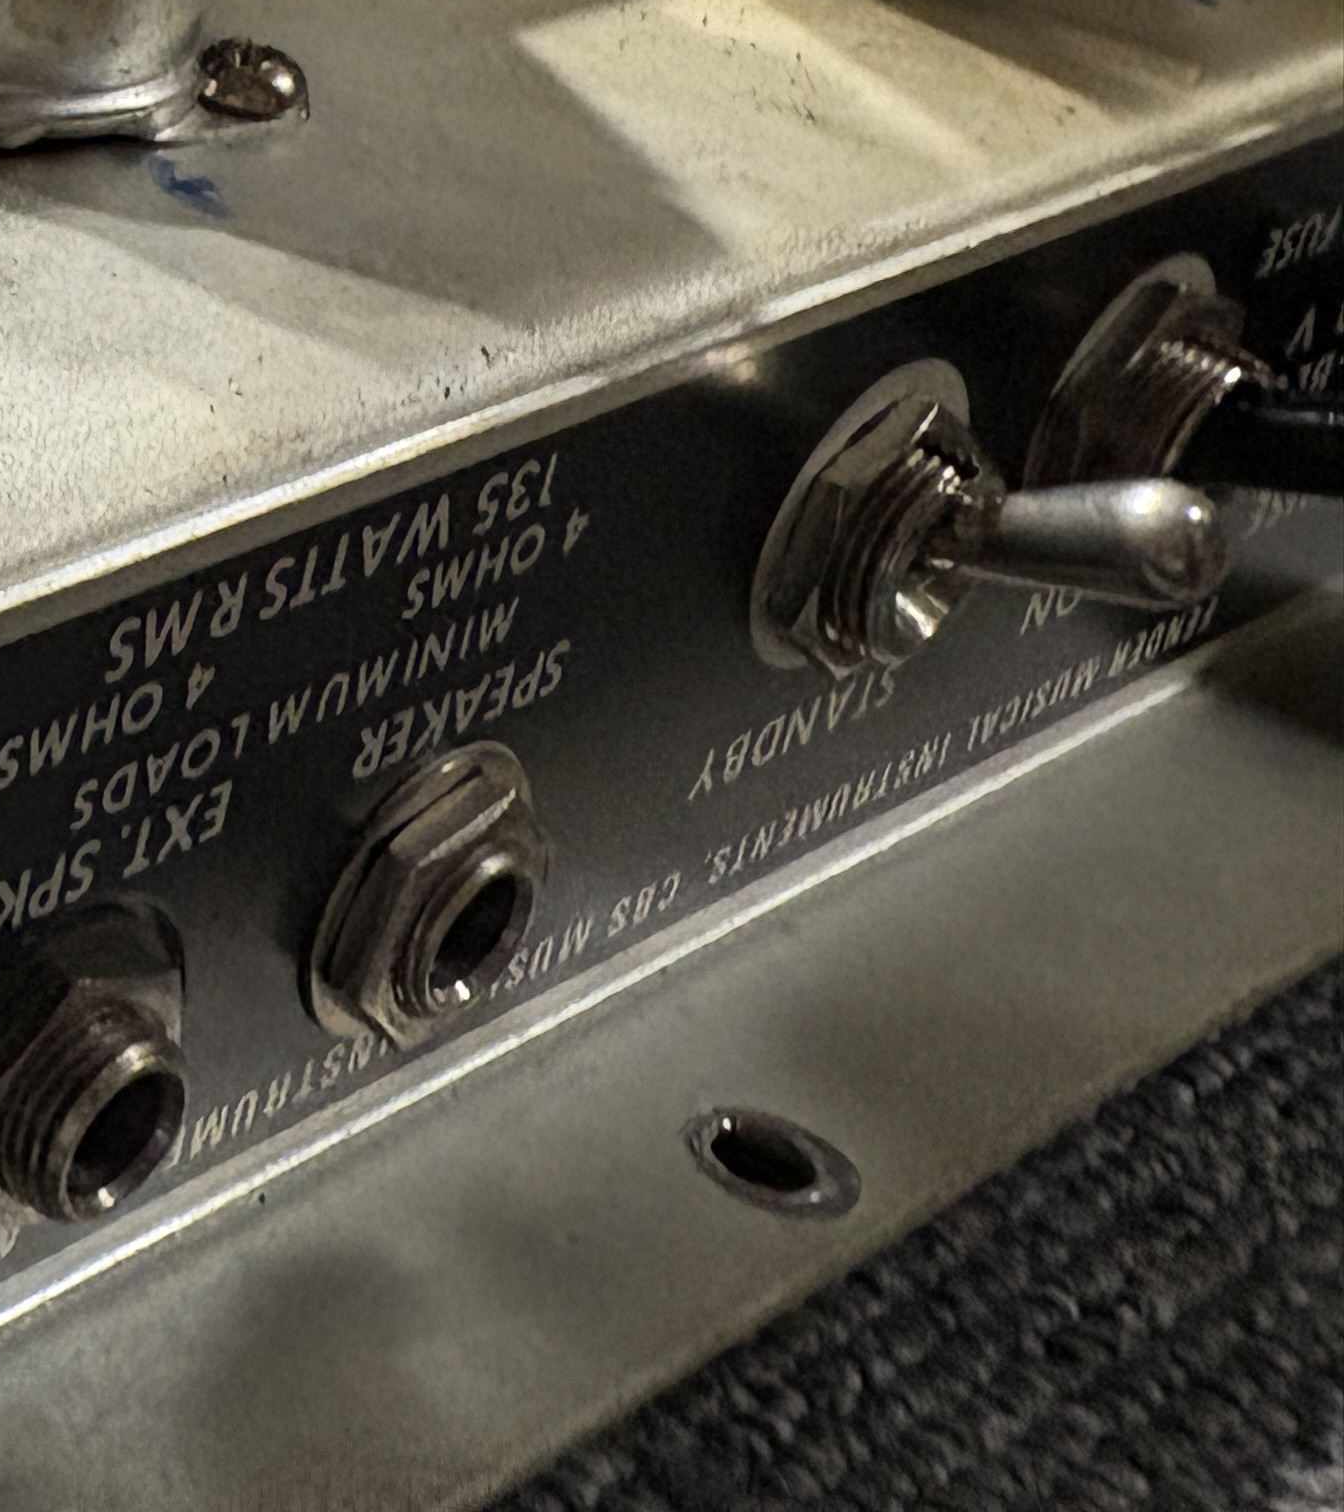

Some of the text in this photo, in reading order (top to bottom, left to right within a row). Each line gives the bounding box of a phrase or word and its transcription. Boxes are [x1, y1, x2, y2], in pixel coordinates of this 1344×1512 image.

[104, 450, 559, 685] 135 WATTS RMS
[400, 506, 591, 621] 4 OHMS
[69, 595, 521, 832] MINIMUM LOADS
[185, 661, 217, 711] 4
[351, 638, 572, 780] SPEAKER
[687, 652, 898, 802] STANDBY
[967, 654, 1102, 751] MUSICAL
[120, 778, 234, 880] EXT.
